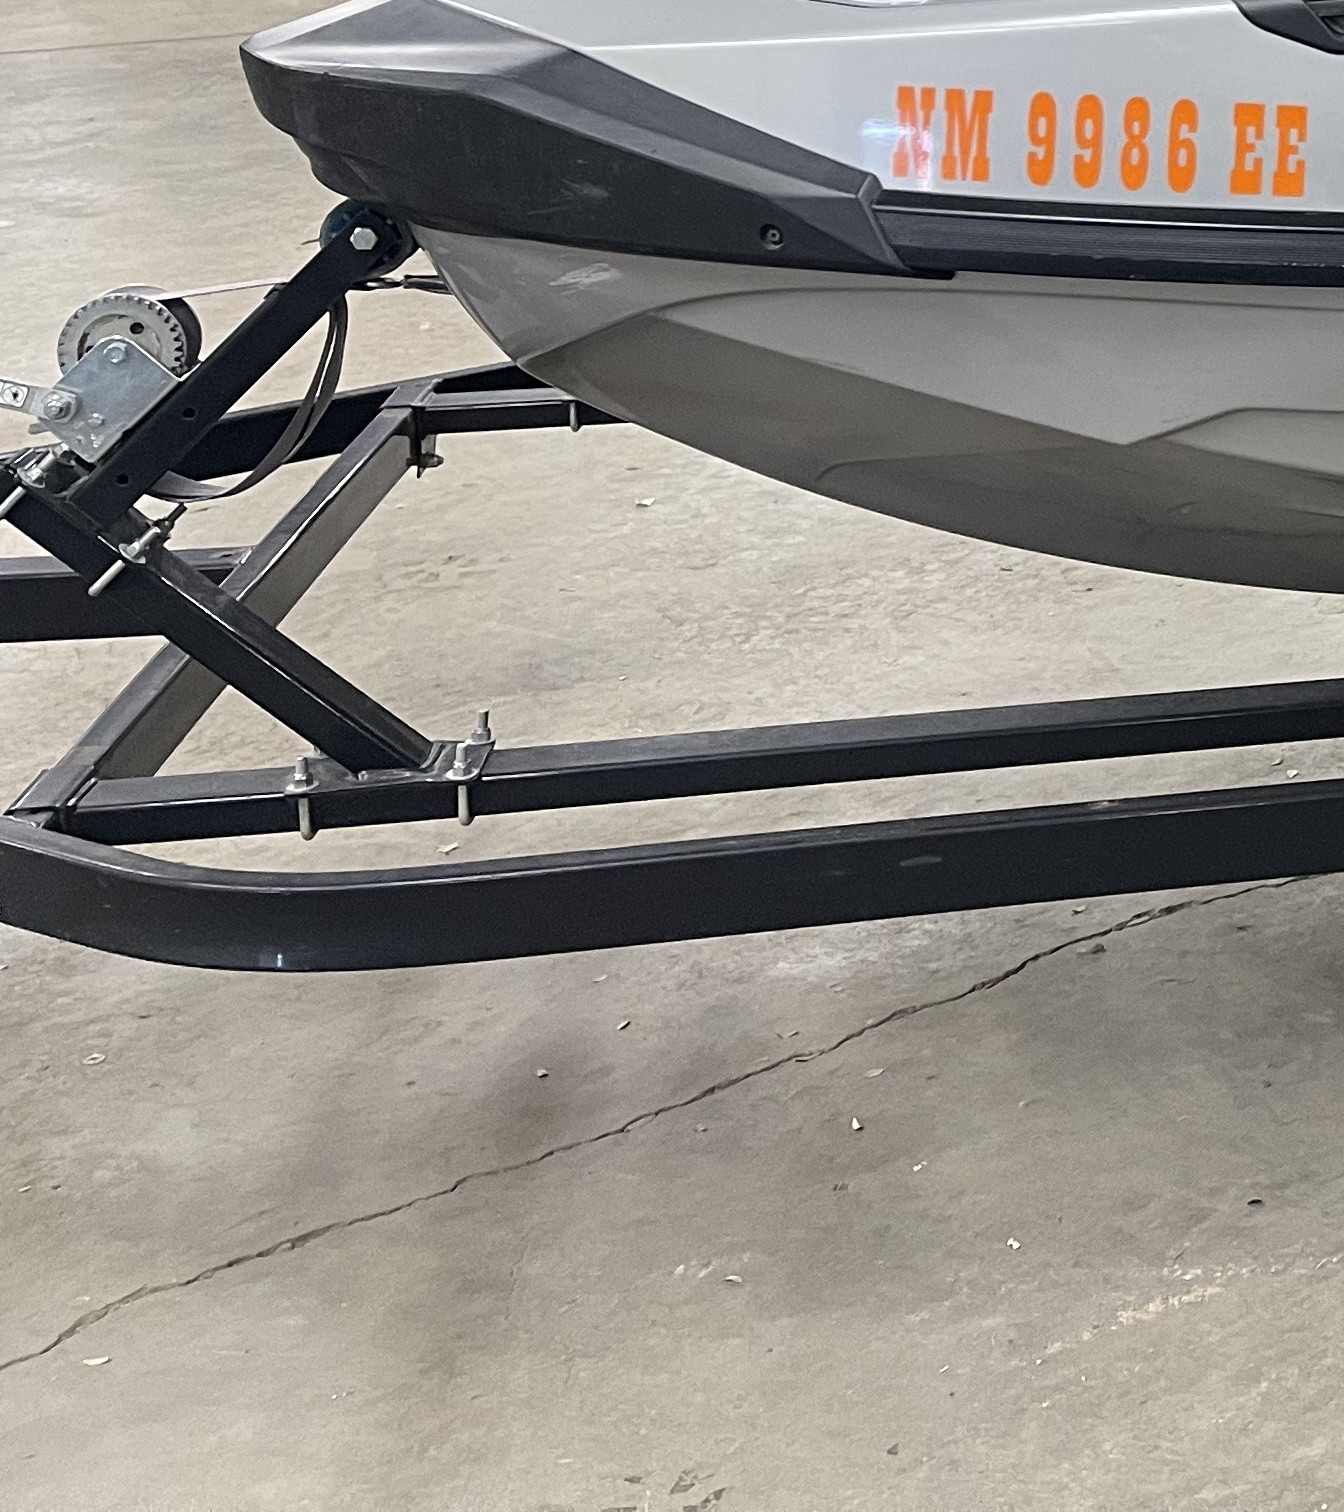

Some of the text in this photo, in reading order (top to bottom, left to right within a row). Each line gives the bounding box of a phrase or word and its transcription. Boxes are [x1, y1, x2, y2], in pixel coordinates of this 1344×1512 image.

[892, 85, 1309, 198] NM 9986 EE
